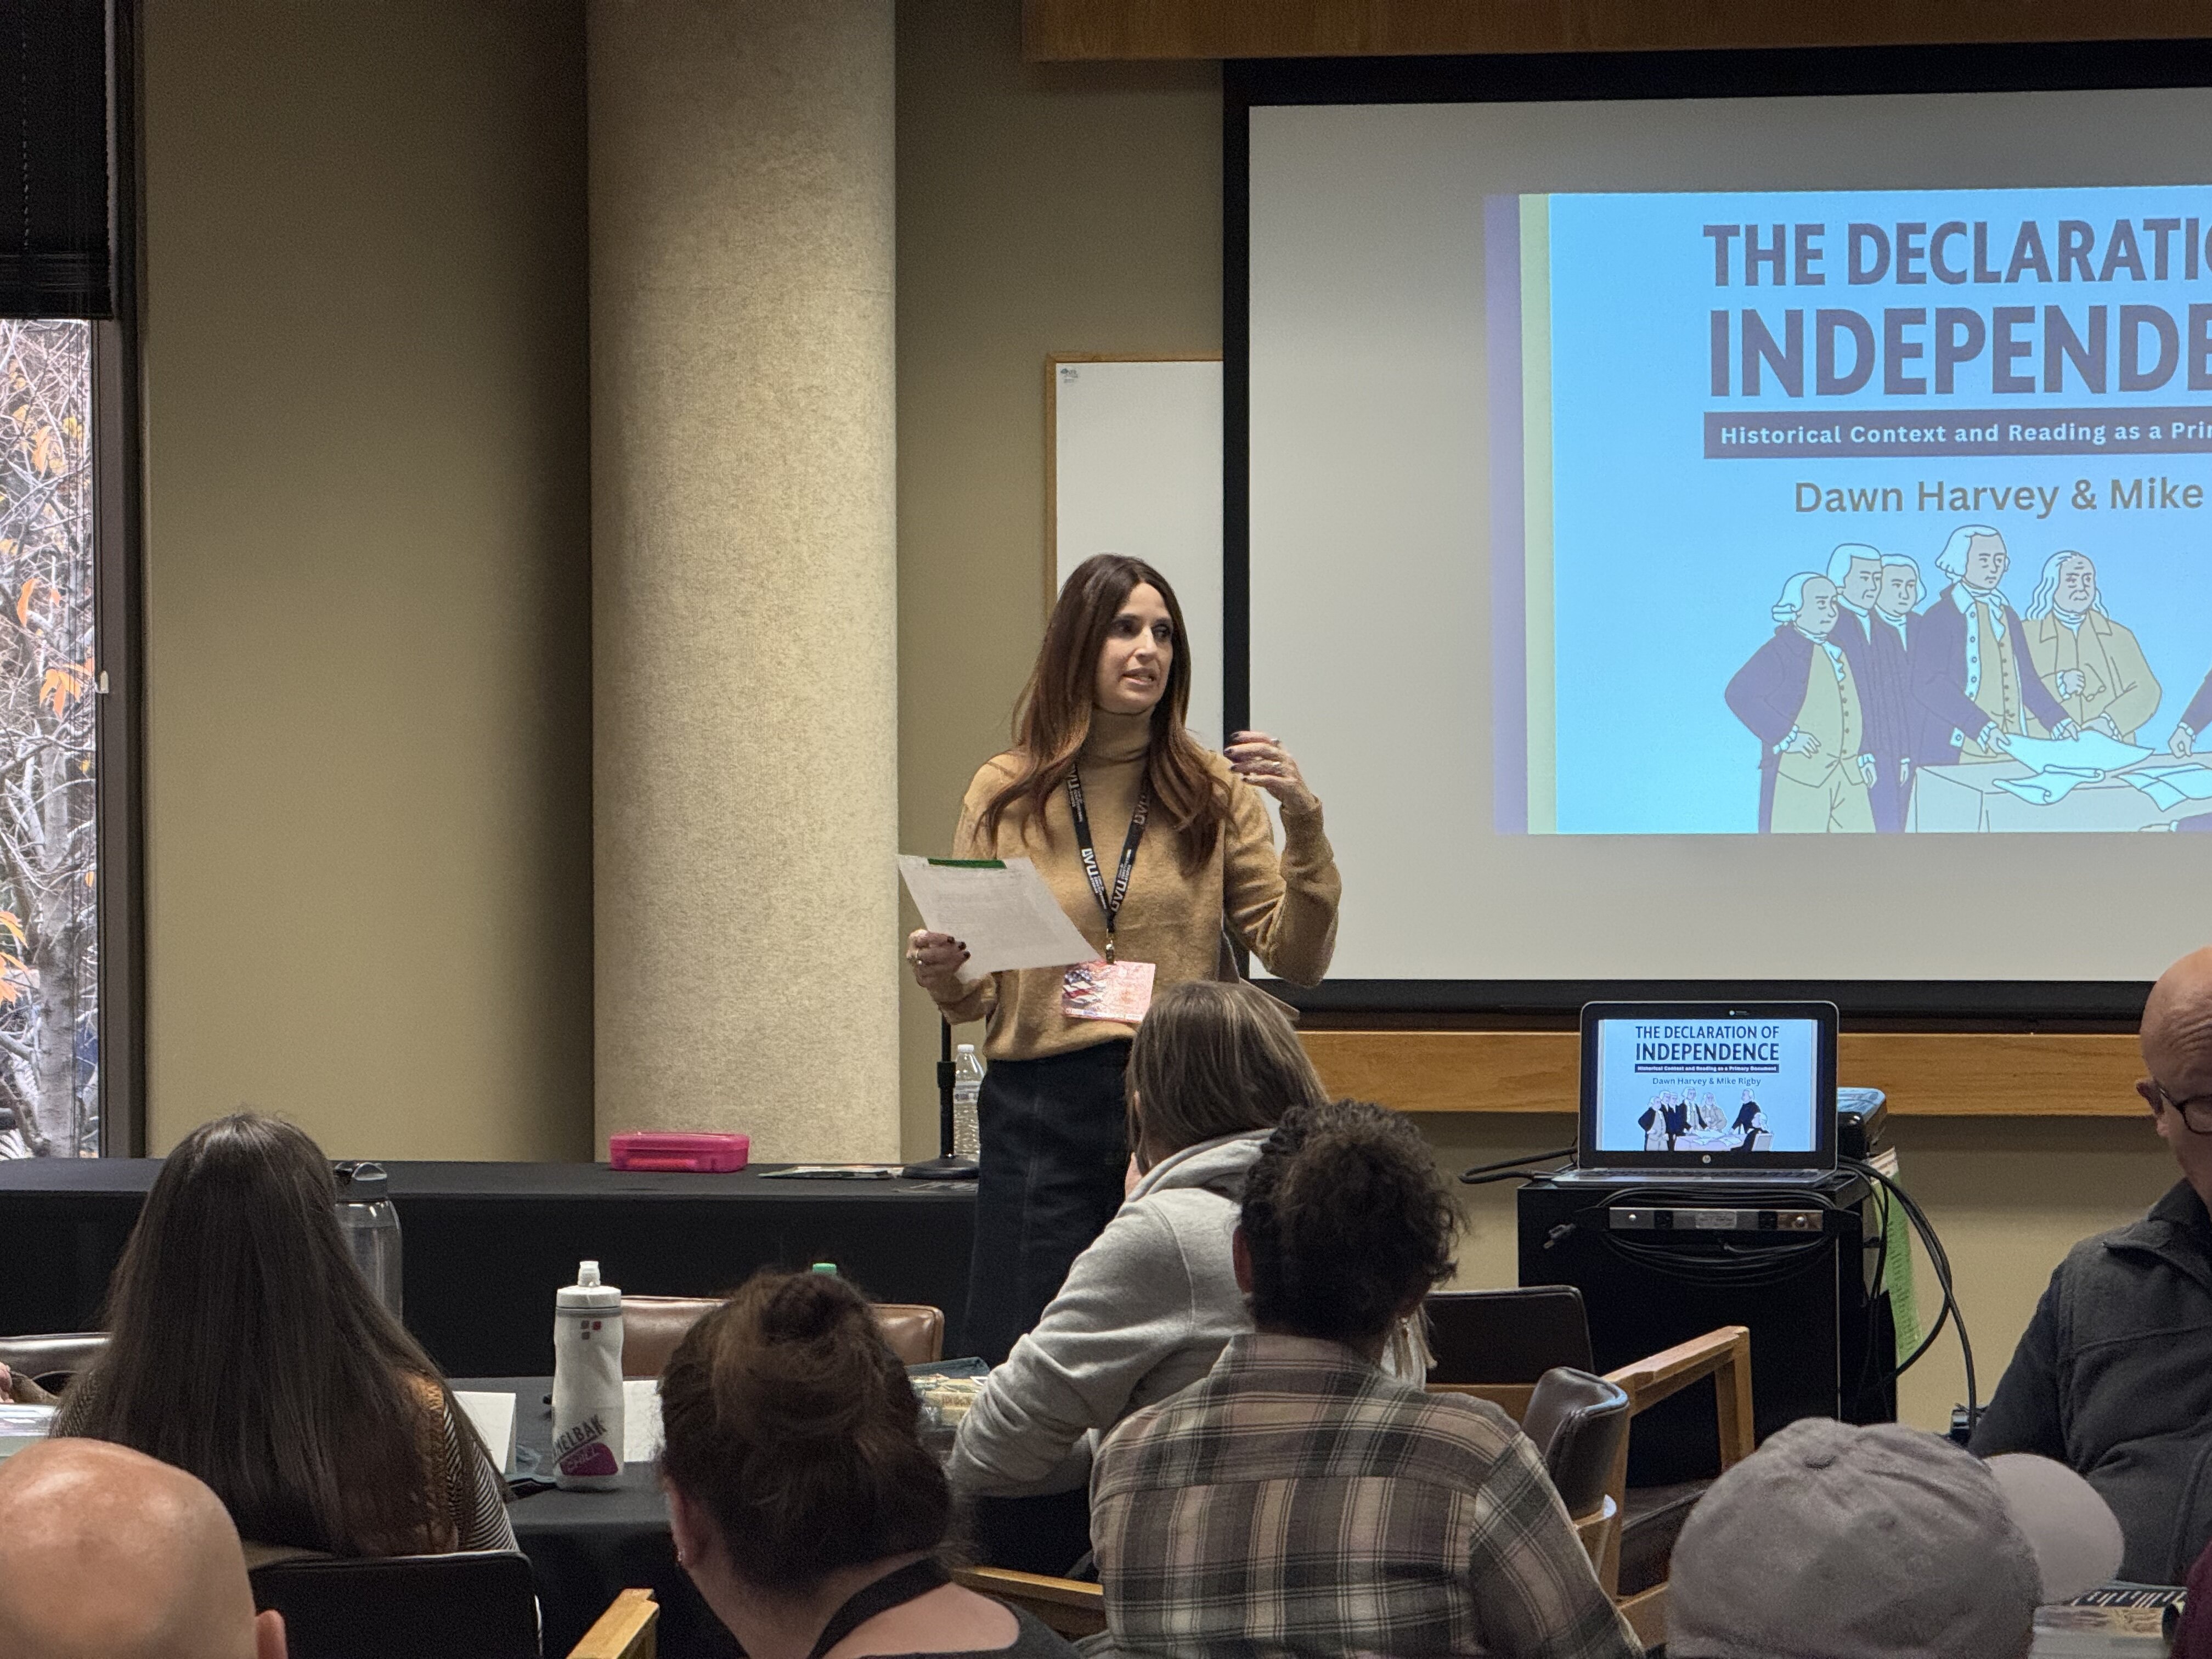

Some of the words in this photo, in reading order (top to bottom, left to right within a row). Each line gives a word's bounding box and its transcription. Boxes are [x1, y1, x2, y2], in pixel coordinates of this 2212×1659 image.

[1703, 223, 1825, 286] THE
[1848, 217, 2212, 285] DECLARATI
[1711, 303, 2212, 398] INDEPENDE
[1721, 425, 1842, 445] Historical
[1850, 426, 1946, 444] Context
[1955, 424, 1999, 442] and
[2008, 422, 2107, 445] Reading
[2115, 426, 2140, 440] as
[2149, 426, 2162, 440] a
[2172, 421, 2212, 439] Pri
[1796, 482, 1903, 513] Dawn
[1918, 481, 2059, 520] Harvey
[2071, 479, 2097, 510] &
[2111, 476, 2204, 510] Mike
[1635, 1026, 1660, 1039] THE
[1664, 1026, 1757, 1039] DECLARATION
[1761, 1026, 1779, 1039] OF
[1636, 1043, 1779, 1061] INDEPENDENCE
[1678, 1077, 1707, 1086] Harvey
[1739, 1077, 1761, 1086] Rigby
